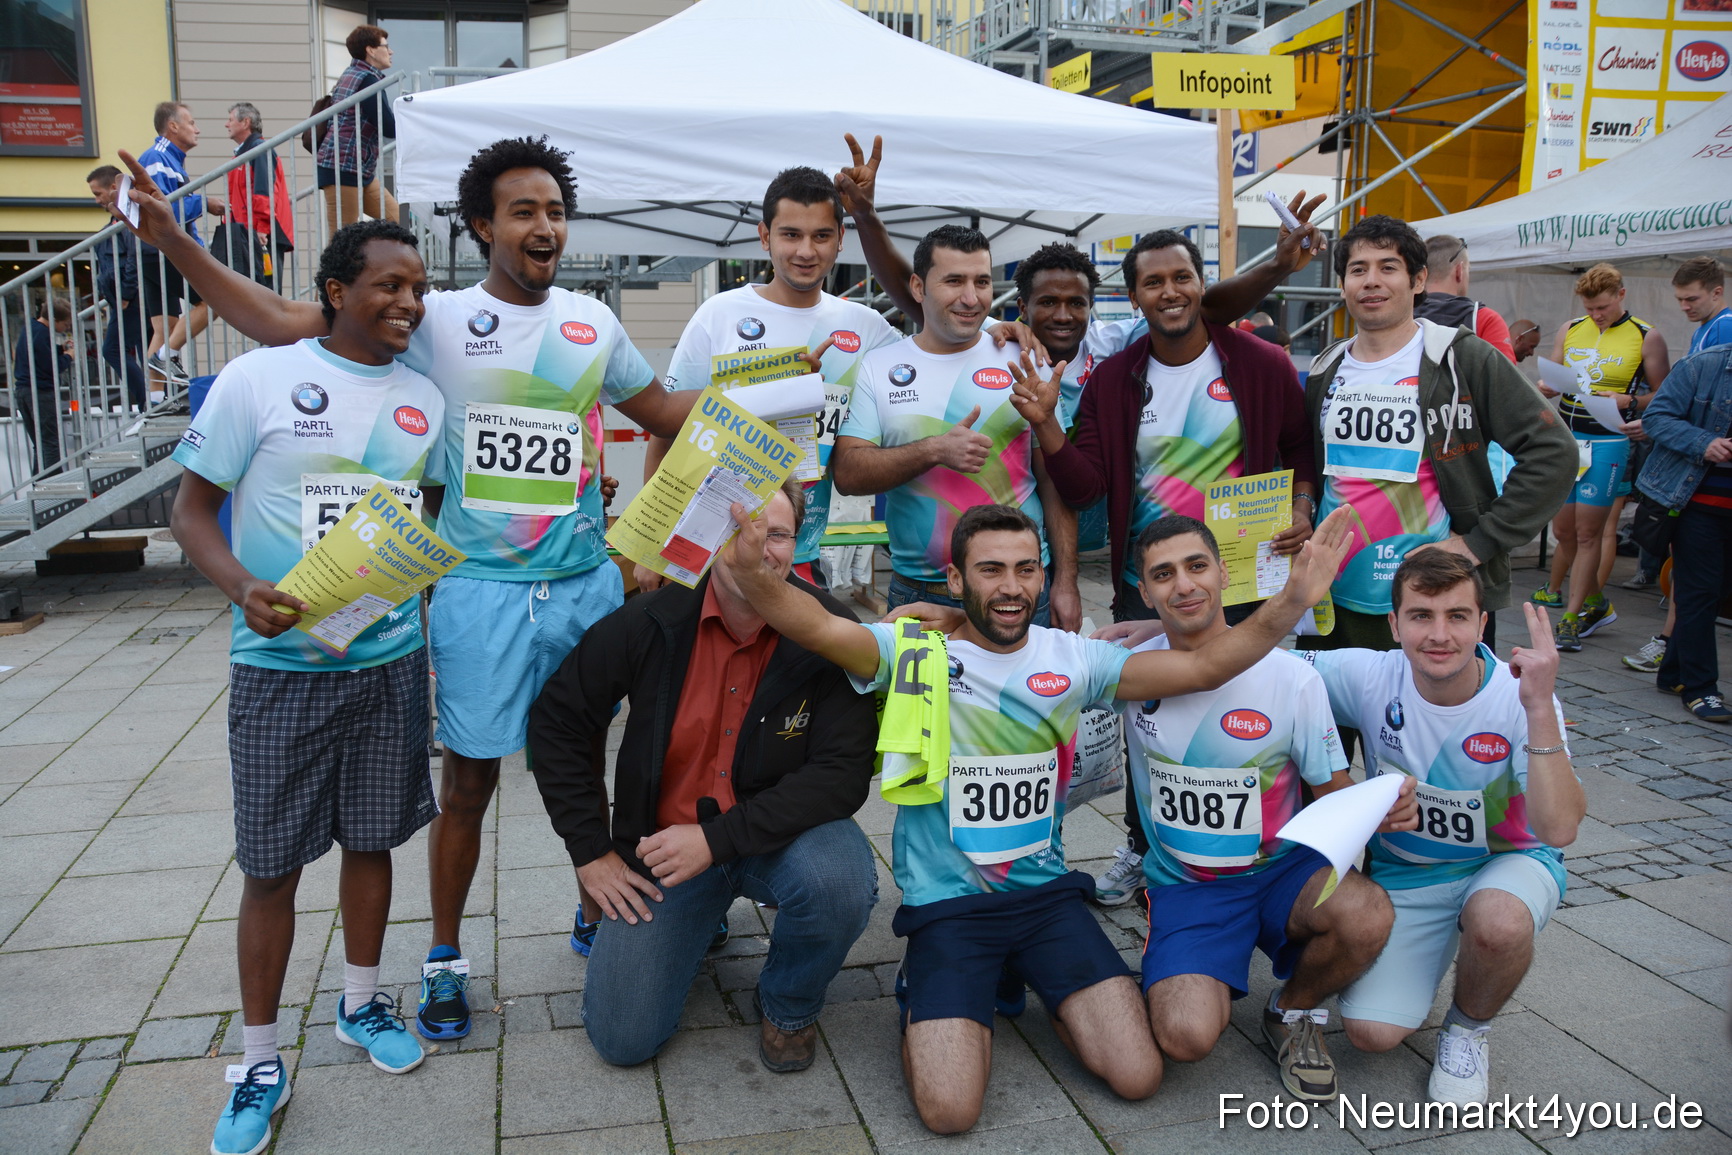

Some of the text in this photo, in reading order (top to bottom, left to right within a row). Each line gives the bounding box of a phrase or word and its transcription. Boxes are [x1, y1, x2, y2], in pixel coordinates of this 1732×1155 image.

[1680, 48, 1726, 73] Hervis
[1543, 63, 1582, 75] NATHUS
[1052, 71, 1083, 90] Toiletten
[1179, 69, 1273, 99] Infopoint
[1590, 121, 1632, 136] swn
[564, 325, 594, 339] Hervis
[465, 341, 502, 350] PARTL
[465, 349, 503, 357] Neumarkt
[748, 368, 805, 384] Neumarkter
[978, 372, 1008, 384] Hervis
[889, 390, 919, 399] PARTL
[889, 397, 919, 405] Neumarkt
[1335, 393, 1412, 404] PARTL Neumarkt
[399, 412, 426, 428] Hervis
[468, 412, 563, 432] PARTL Neumarkt
[1140, 410, 1157, 418] RTL
[294, 420, 333, 430] PARTL
[701, 396, 797, 469] URKUNDE
[1335, 406, 1417, 444] 3083
[294, 430, 333, 438] Neumarkt
[476, 430, 572, 476] 5328
[687, 420, 781, 484] 16. Neumarkter
[305, 485, 348, 496] PARTL
[1210, 476, 1289, 500] URKUNDE
[1209, 494, 1288, 521] 16. Neumarkter
[1238, 503, 1278, 518] Stadtlauf
[369, 492, 458, 568] URKUNDE
[350, 510, 380, 550] 16.
[384, 538, 439, 577] Neumarkter
[1375, 544, 1399, 559] 16.
[375, 546, 423, 580] Stadtlauf
[1032, 677, 1066, 689] Hervis
[1228, 715, 1266, 732] Hervis
[1469, 739, 1505, 756] Hervis
[952, 763, 1045, 776] PARTL Neumarkt
[1150, 768, 1238, 788] PARTL Neumarkt
[963, 777, 1050, 822] 3086
[1159, 786, 1249, 829] 3087
[1416, 791, 1462, 808] eumarkt
